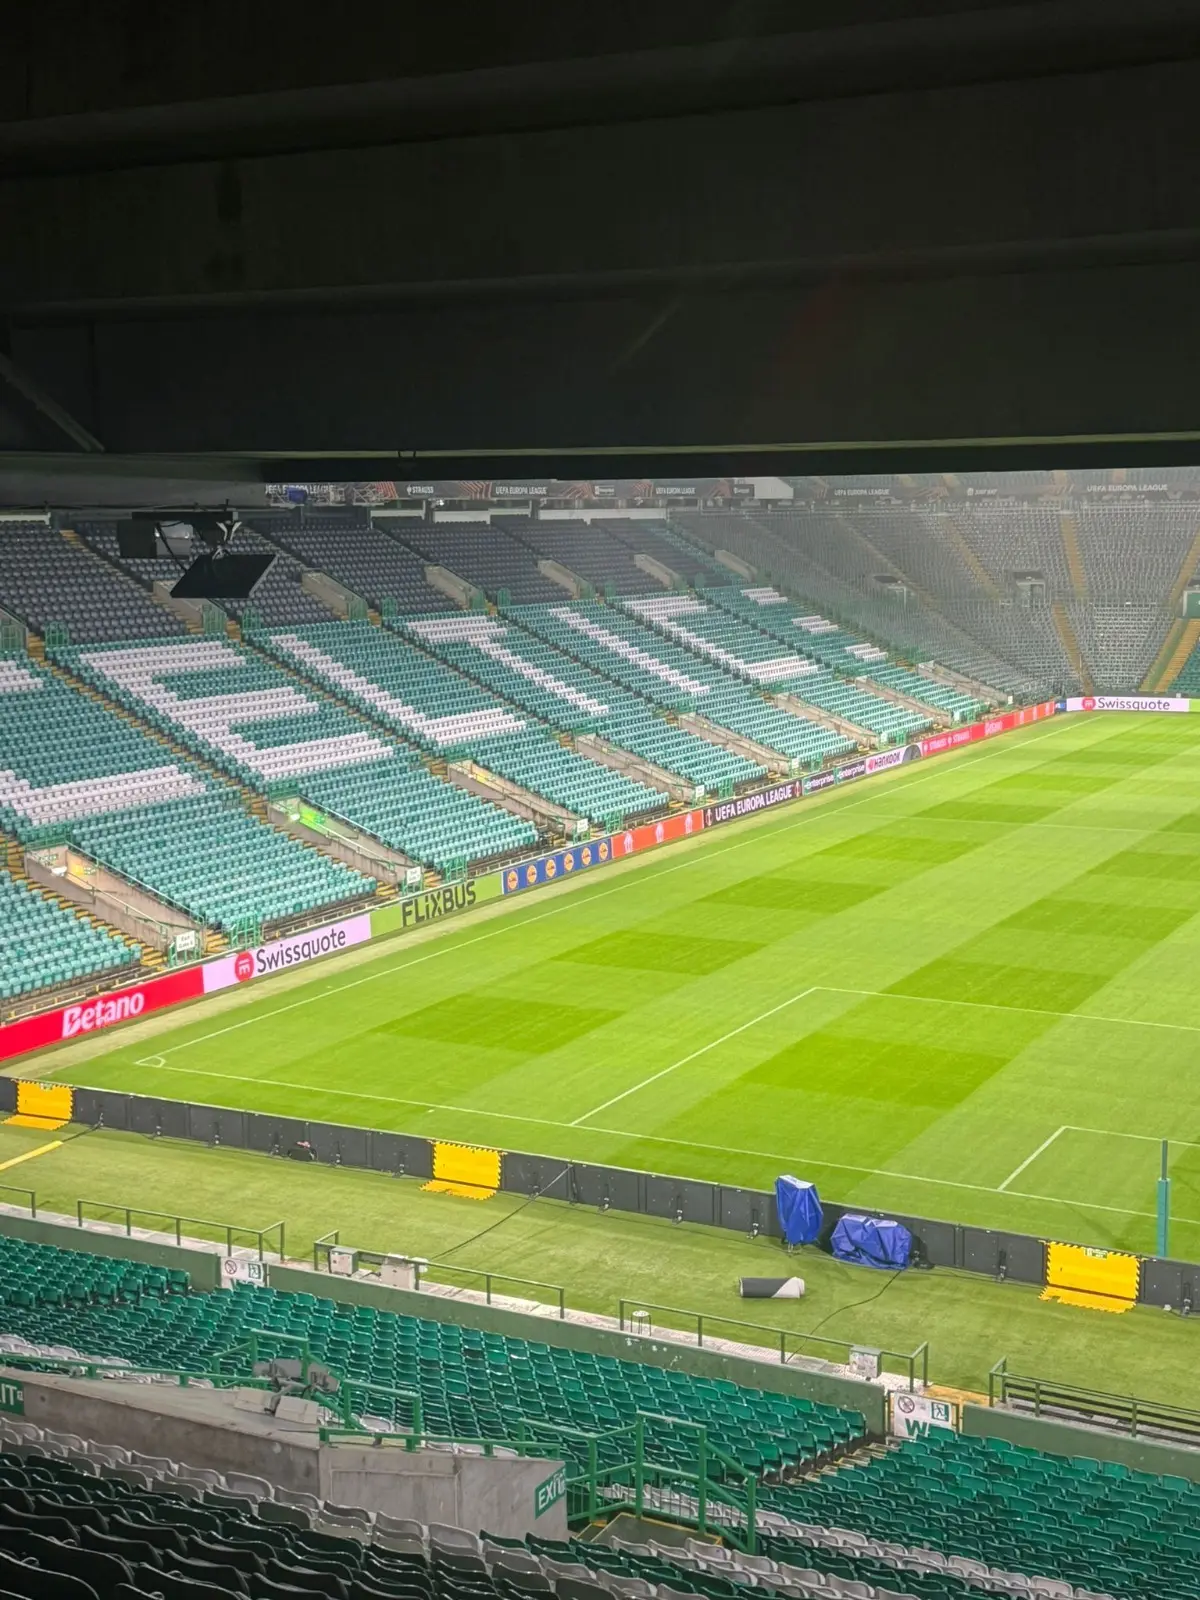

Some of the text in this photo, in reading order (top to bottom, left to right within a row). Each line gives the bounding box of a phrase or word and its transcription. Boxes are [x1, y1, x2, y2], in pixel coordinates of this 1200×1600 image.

[495, 486, 548, 495] UEFA EUROPA LEAGUE
[868, 488, 890, 496] LEAGUE
[1108, 484, 1138, 492] EUROPA
[1138, 483, 1169, 492] LEAGUE
[1098, 697, 1171, 710] Swissquote
[716, 784, 793, 821] UEFA EUROPA LEAGUE
[256, 928, 346, 973] Swissquote
[61, 992, 145, 1039] Betano
